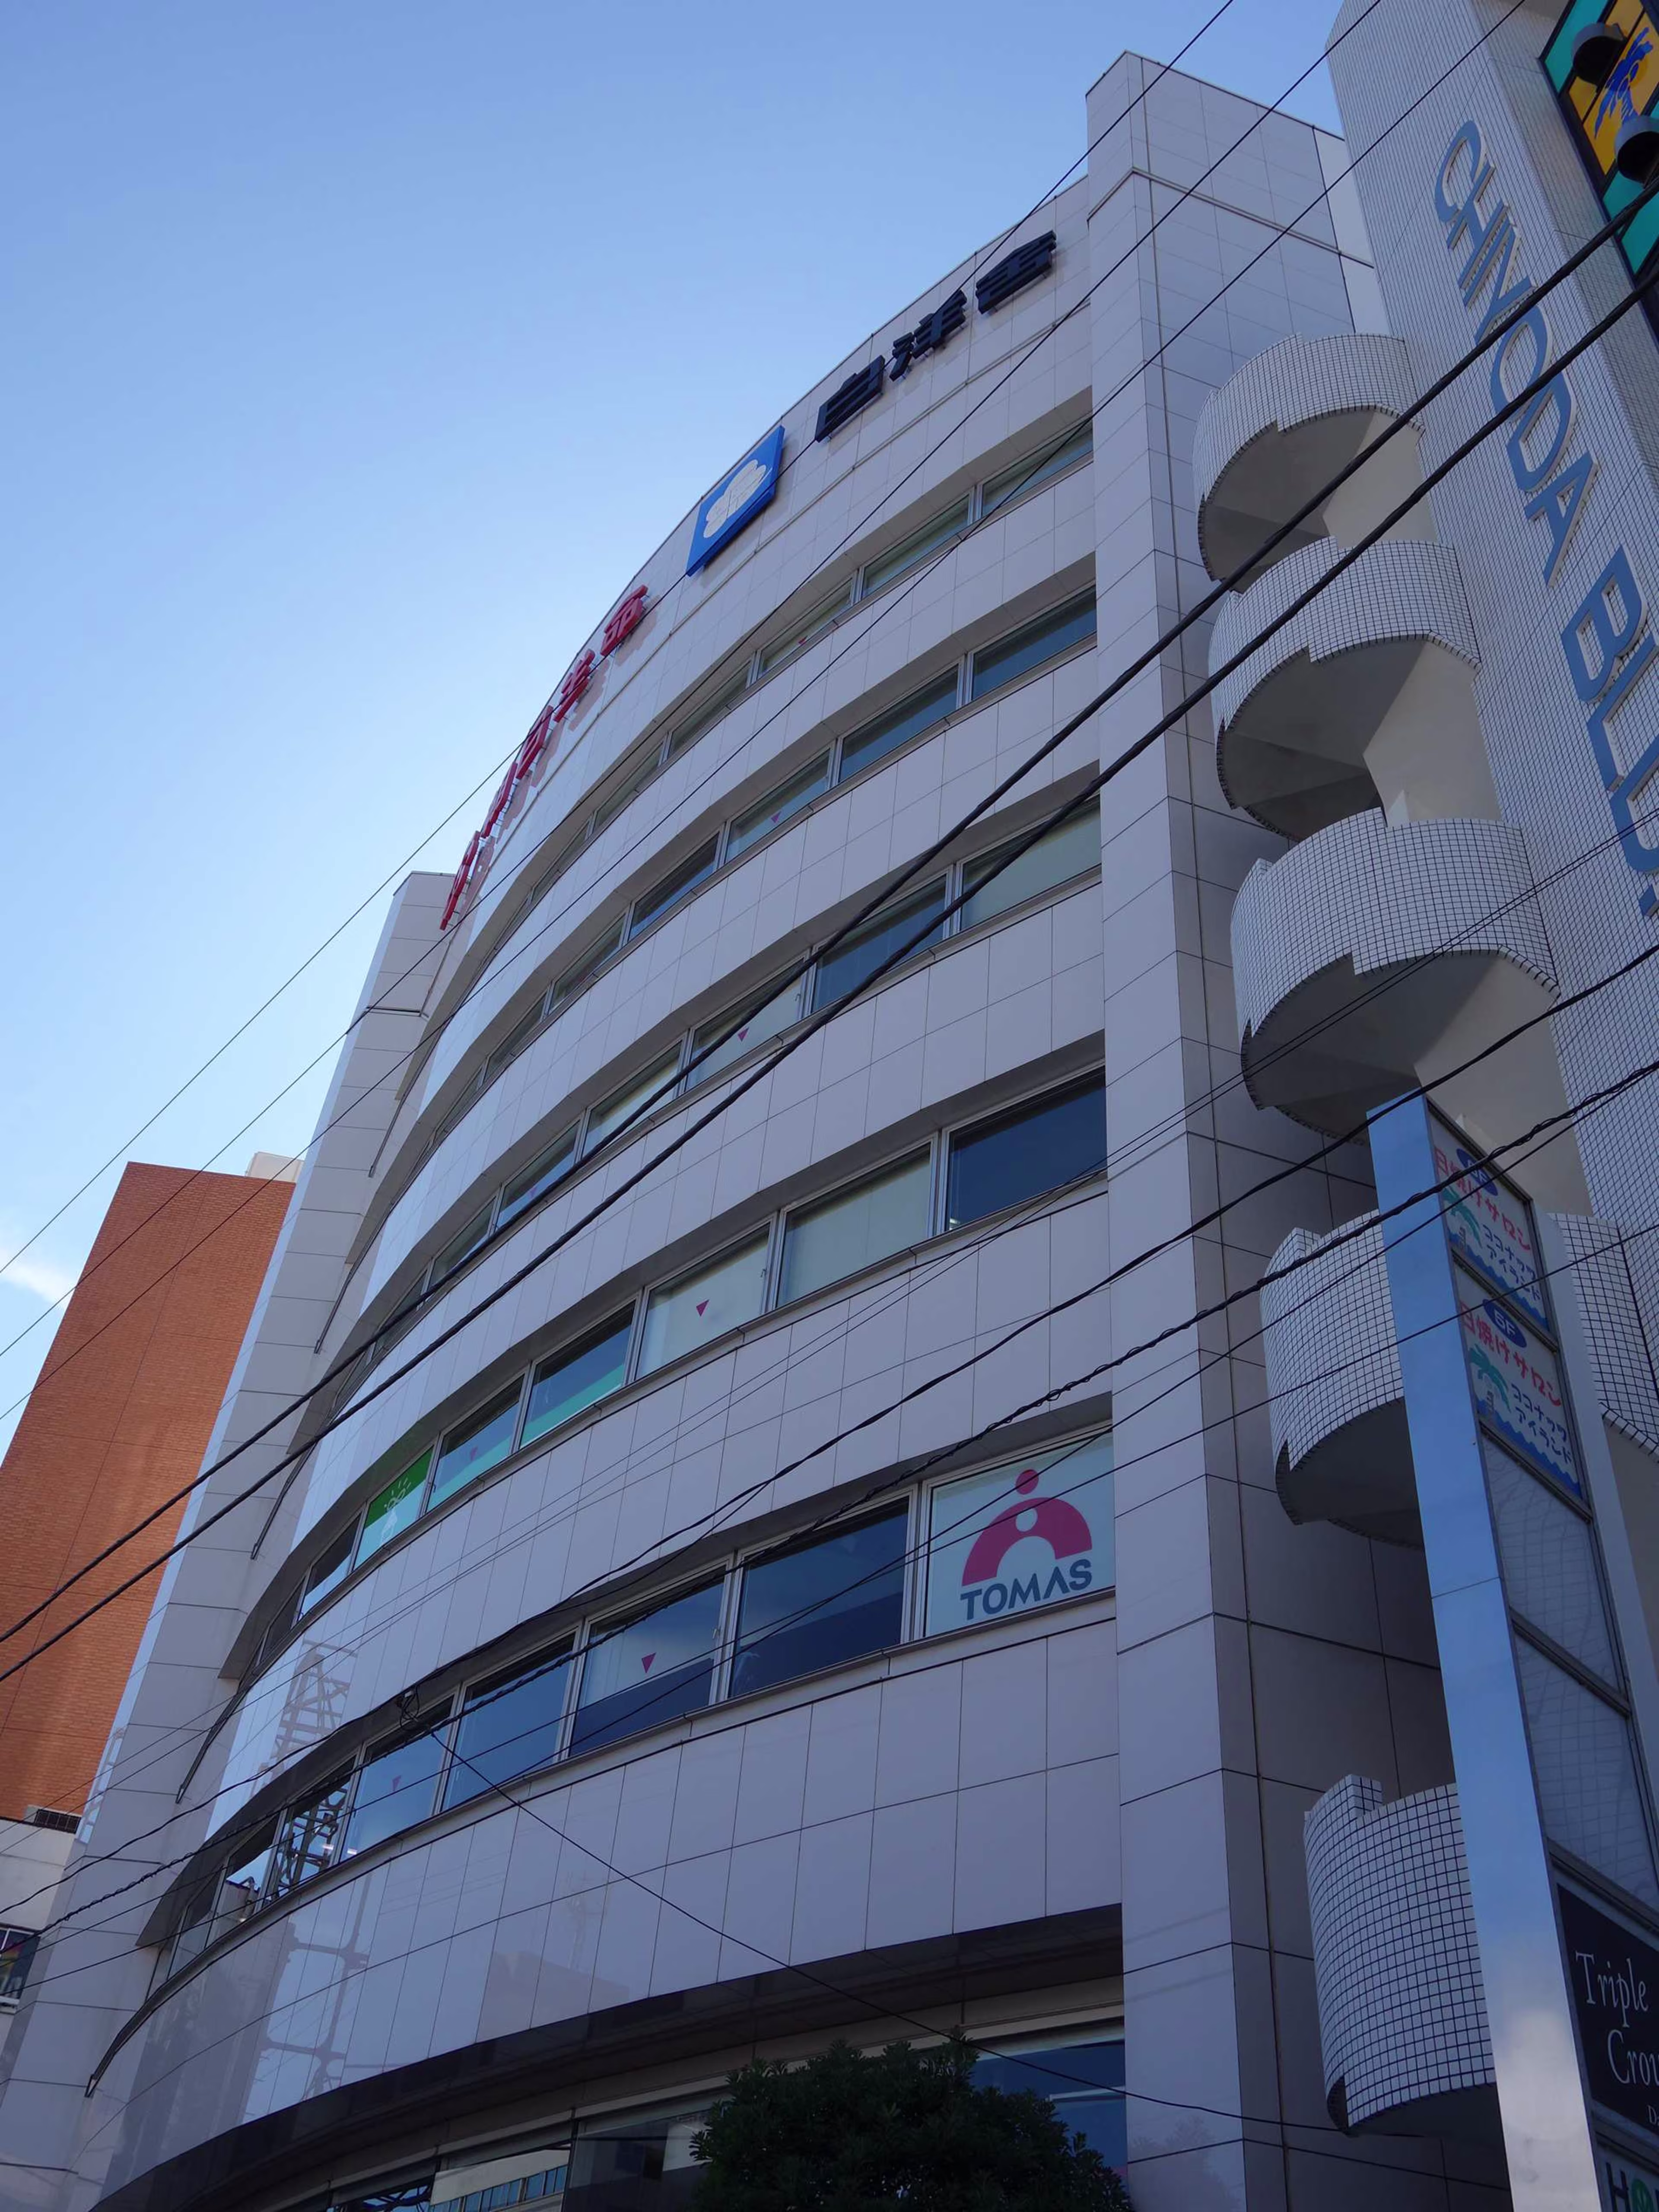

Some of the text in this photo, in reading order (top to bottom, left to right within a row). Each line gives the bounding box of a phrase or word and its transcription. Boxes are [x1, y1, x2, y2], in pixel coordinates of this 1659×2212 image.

[1434, 120, 1597, 588] CHIYODA
[1483, 1224, 1535, 1281] ココナッツ
[1487, 1244, 1541, 1301] アイランド
[1459, 1299, 1561, 1407] 日焼けサロン
[1511, 1383, 1567, 1443] ココナッツ
[1516, 1407, 1572, 1464] アイランド
[960, 1559, 1092, 1621] TOMAS
[1575, 1951, 1649, 2028] Triple
